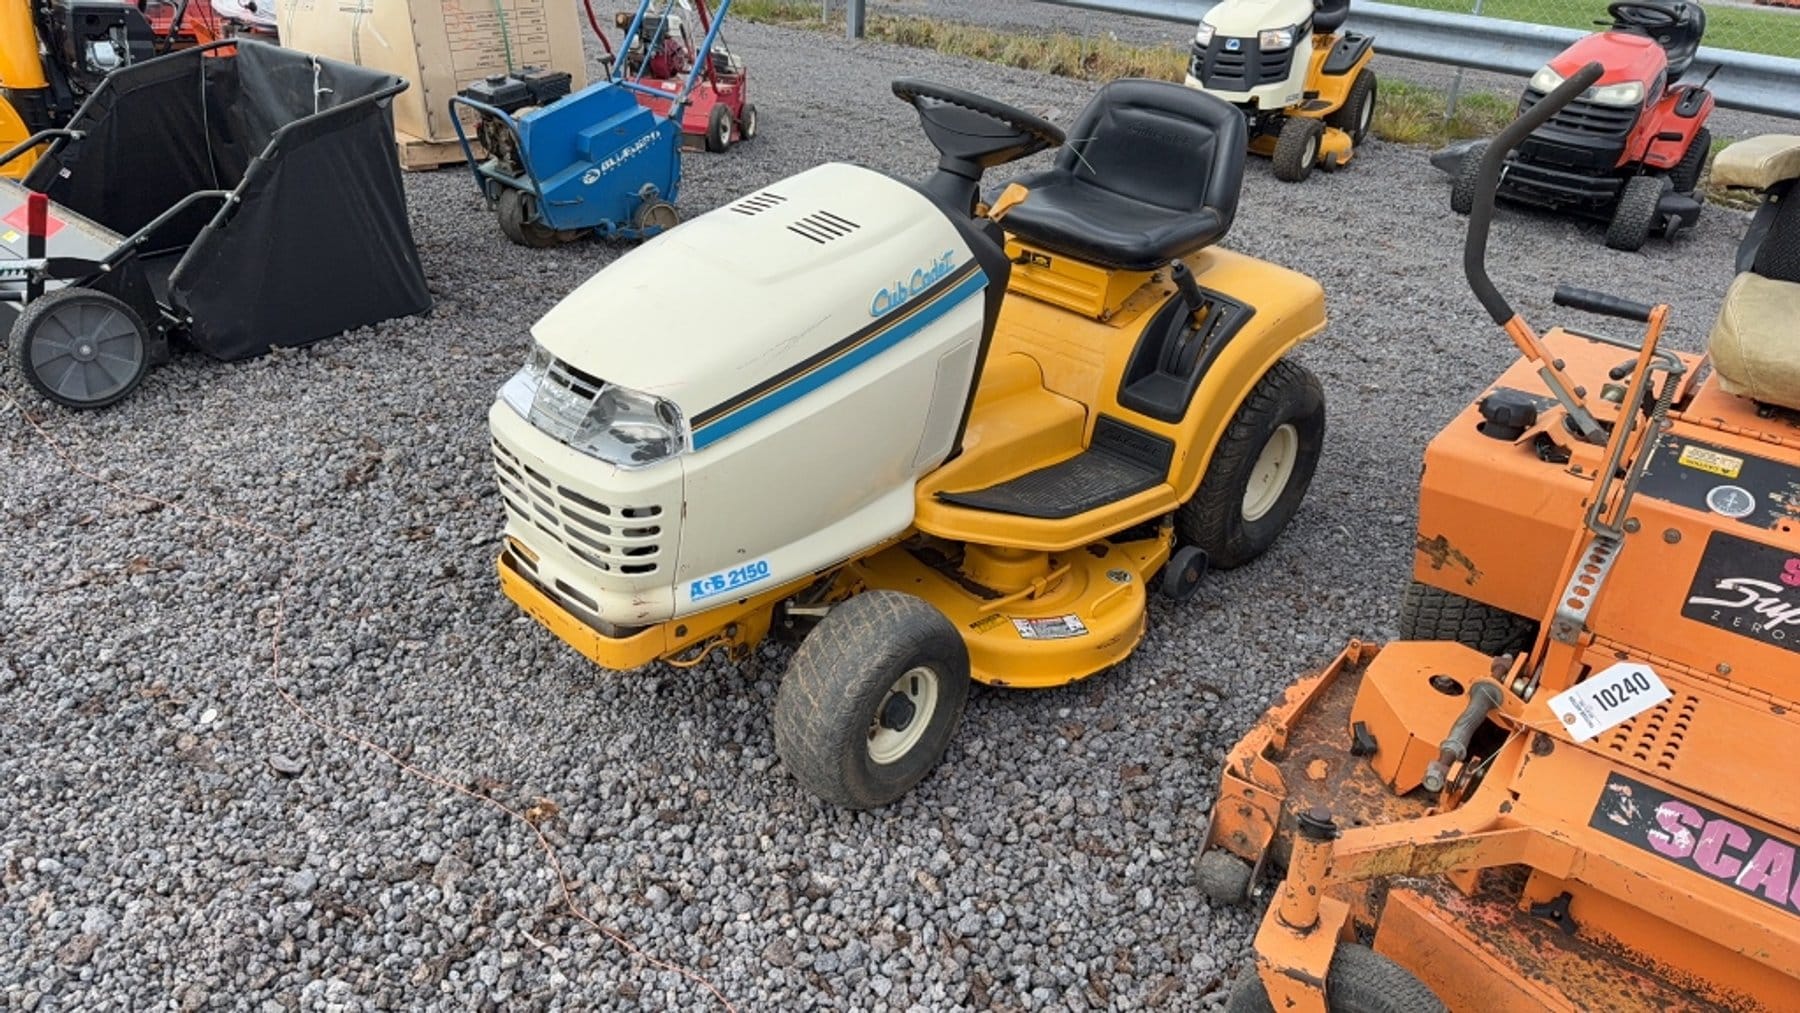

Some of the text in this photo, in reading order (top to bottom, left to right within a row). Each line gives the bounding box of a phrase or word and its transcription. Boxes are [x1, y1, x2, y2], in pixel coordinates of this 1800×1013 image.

[870, 249, 955, 317] Cub Cadet
[728, 560, 768, 585] 2150
[1592, 671, 1651, 712] 10240
[1647, 800, 1800, 911] SCA
